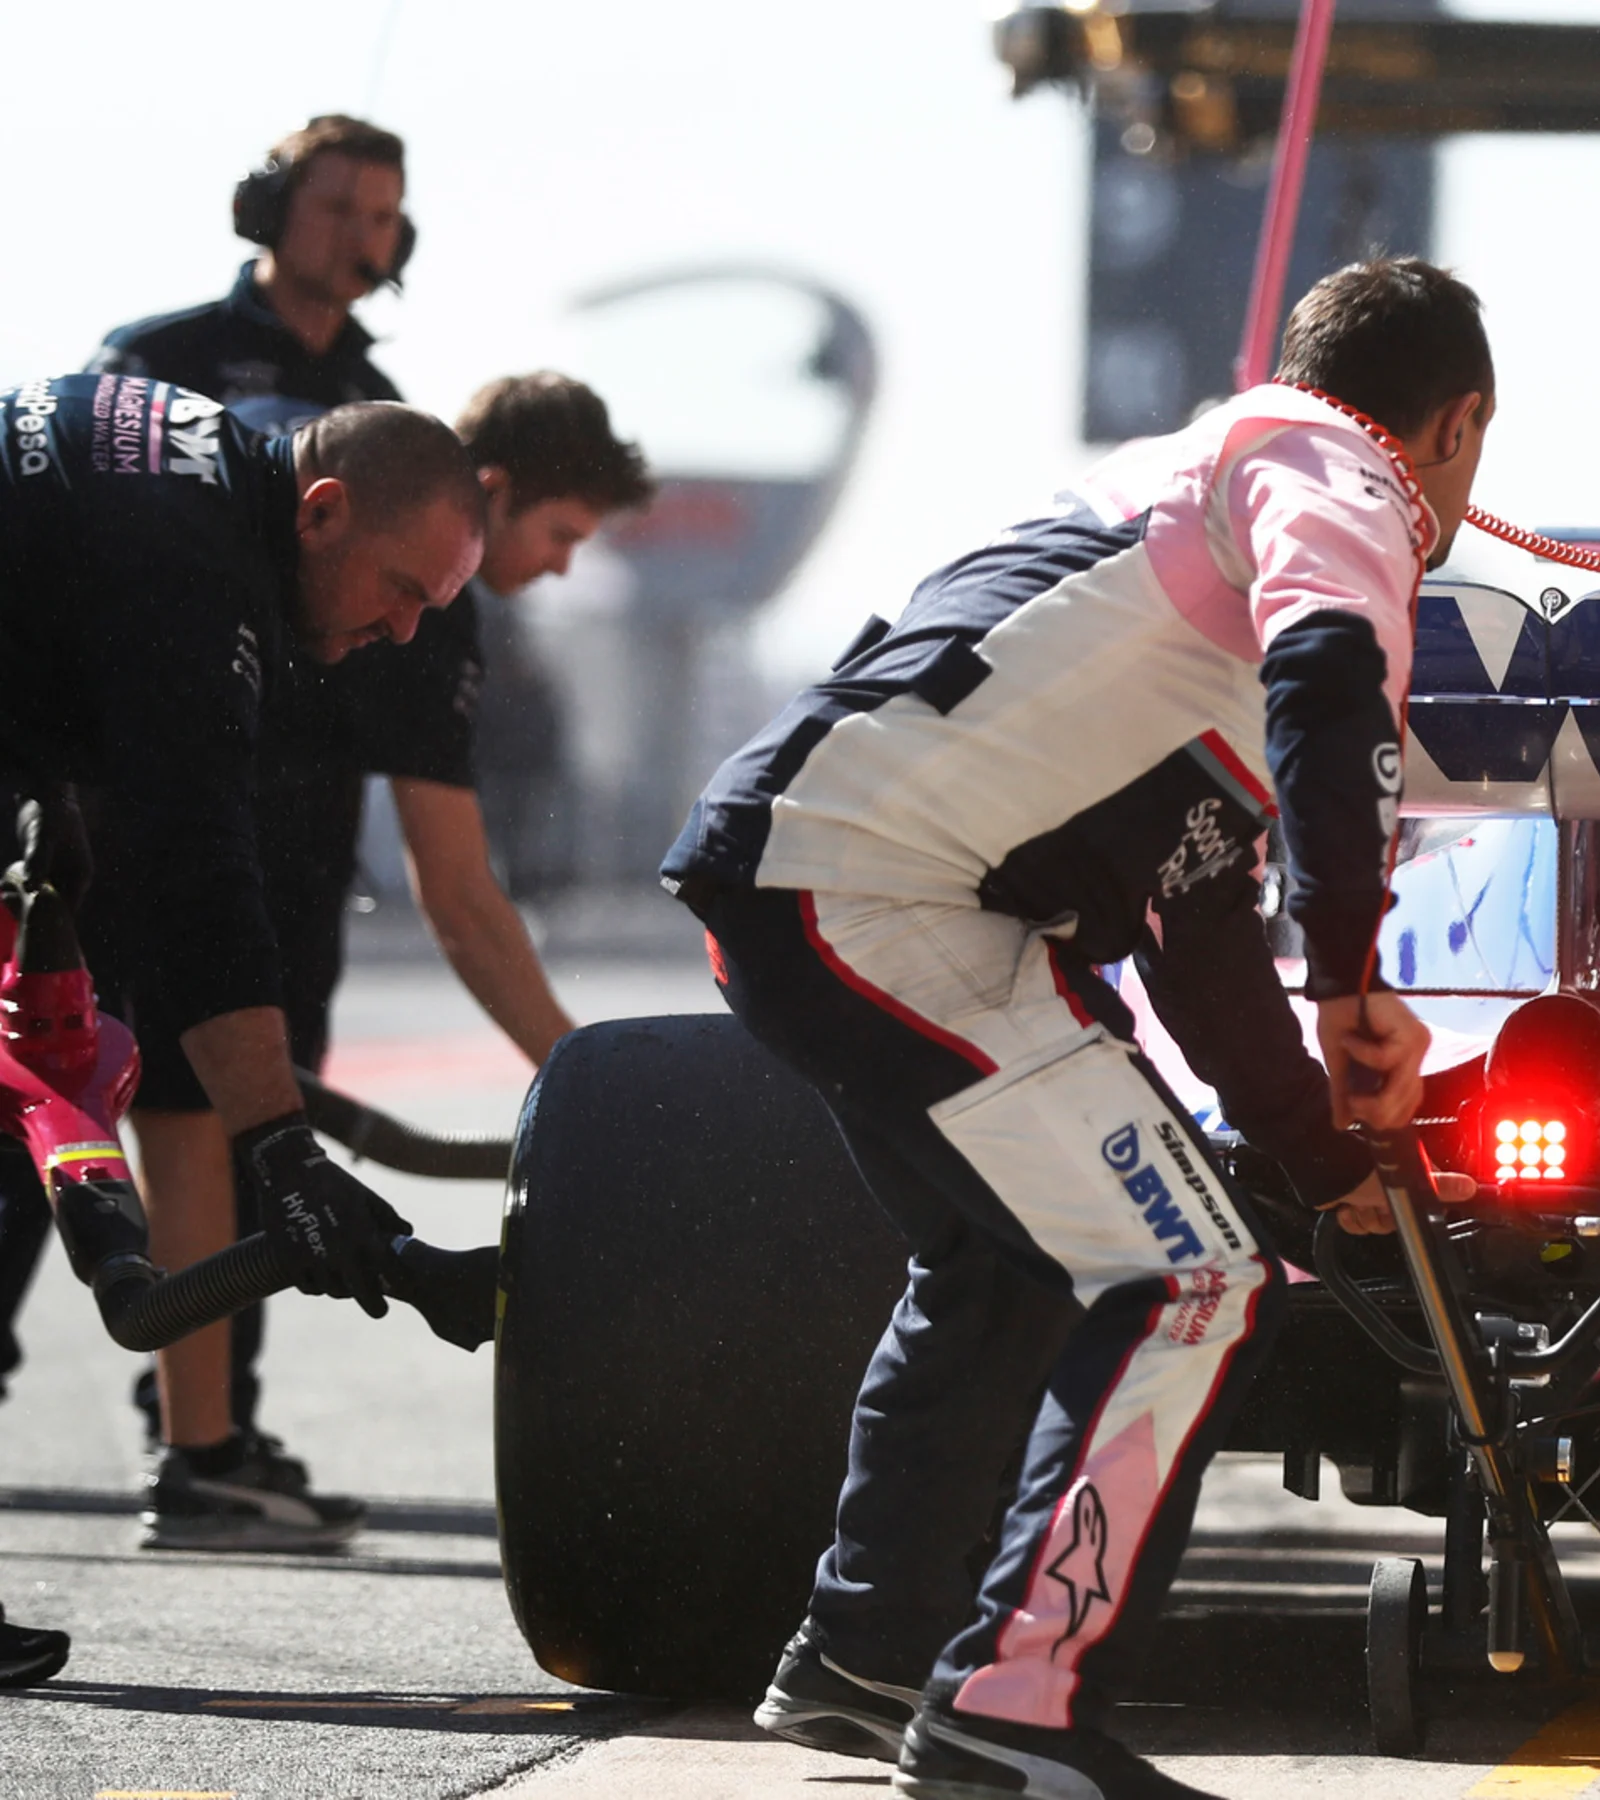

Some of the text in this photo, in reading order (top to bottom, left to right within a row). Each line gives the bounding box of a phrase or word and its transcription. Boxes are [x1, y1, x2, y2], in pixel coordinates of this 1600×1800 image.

[92, 420, 110, 472] WATER
[282, 1191, 327, 1256] HyFlex
[1123, 1163, 1205, 1264] BWT
[1153, 1121, 1242, 1251] Simpson
